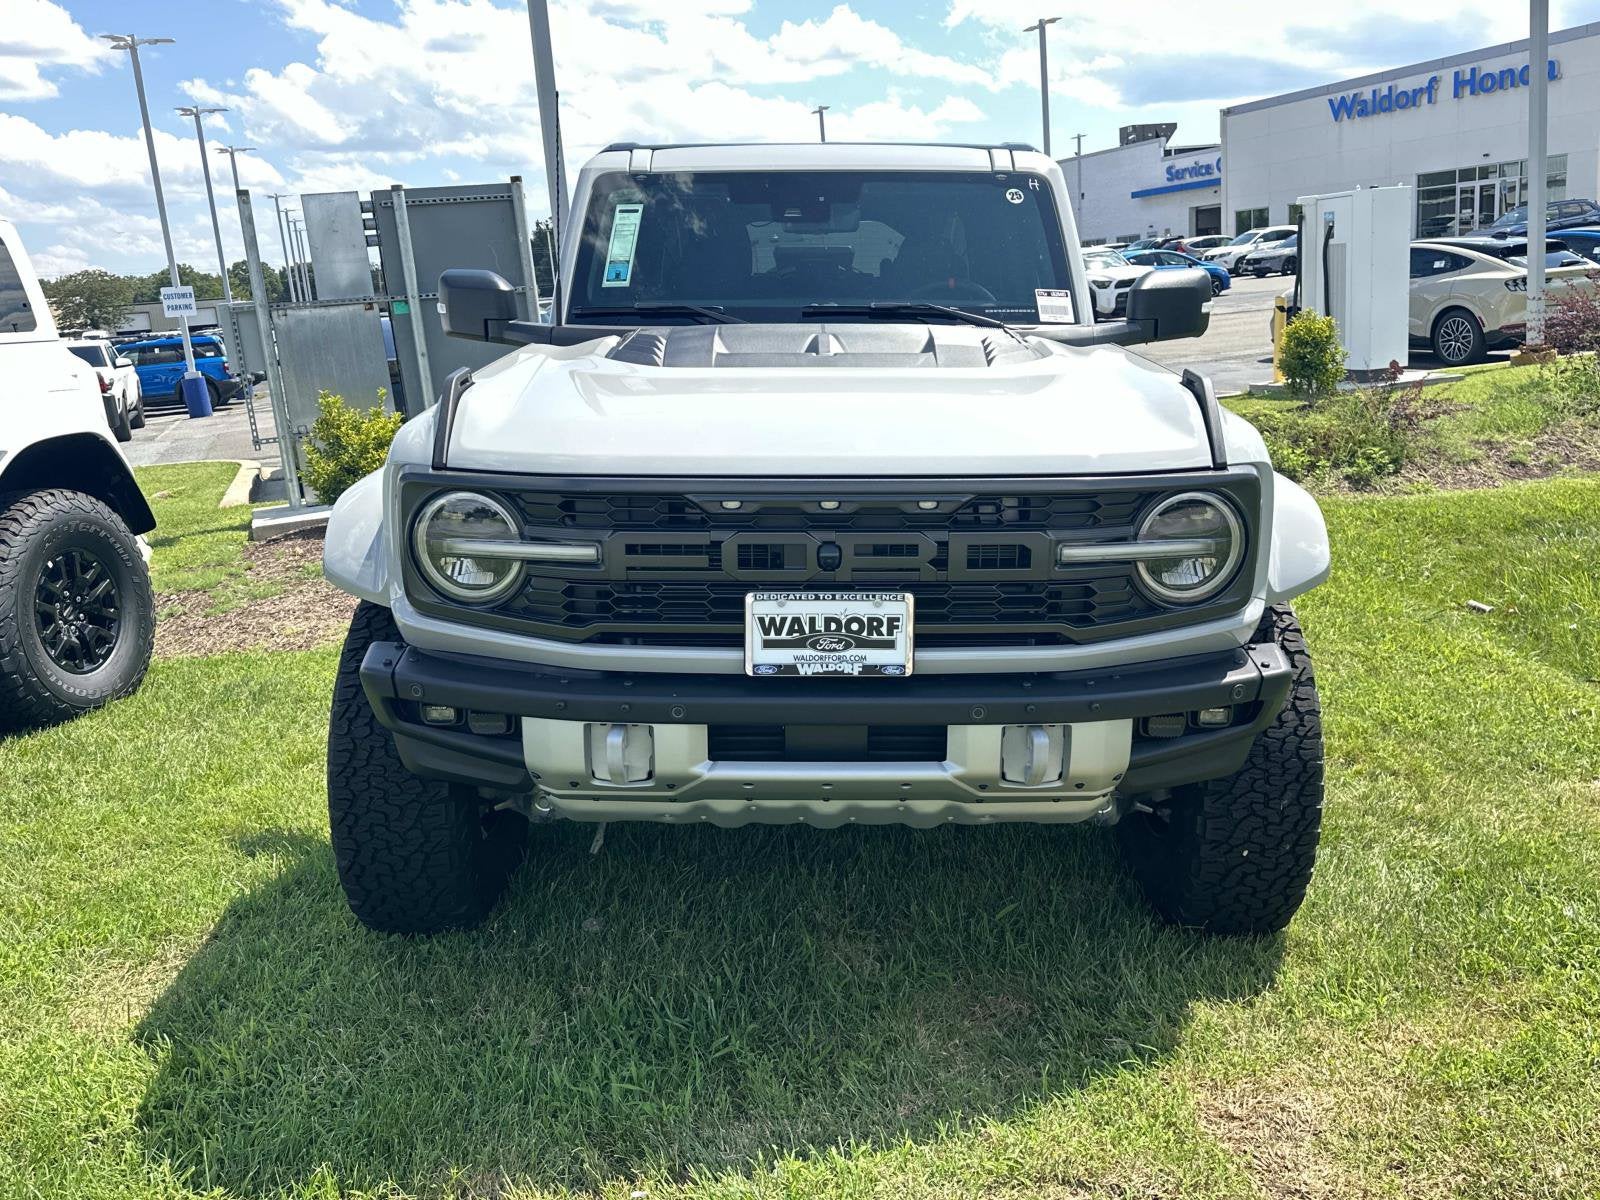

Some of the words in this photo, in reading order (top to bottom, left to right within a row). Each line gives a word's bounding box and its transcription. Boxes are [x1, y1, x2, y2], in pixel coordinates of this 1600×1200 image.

[1327, 75, 1438, 122] Waldorf
[1165, 160, 1214, 182] Service
[1008, 190, 1022, 201] 25
[162, 291, 193, 301] CUSTOMER
[166, 303, 193, 312] PARKING
[605, 529, 1053, 582] FORD
[755, 615, 903, 638] WALDORF
[815, 637, 846, 651] Ford
[792, 654, 868, 662] WALDORFFORD.COM
[756, 665, 777, 674] Ford
[796, 662, 863, 676] WALDORF
